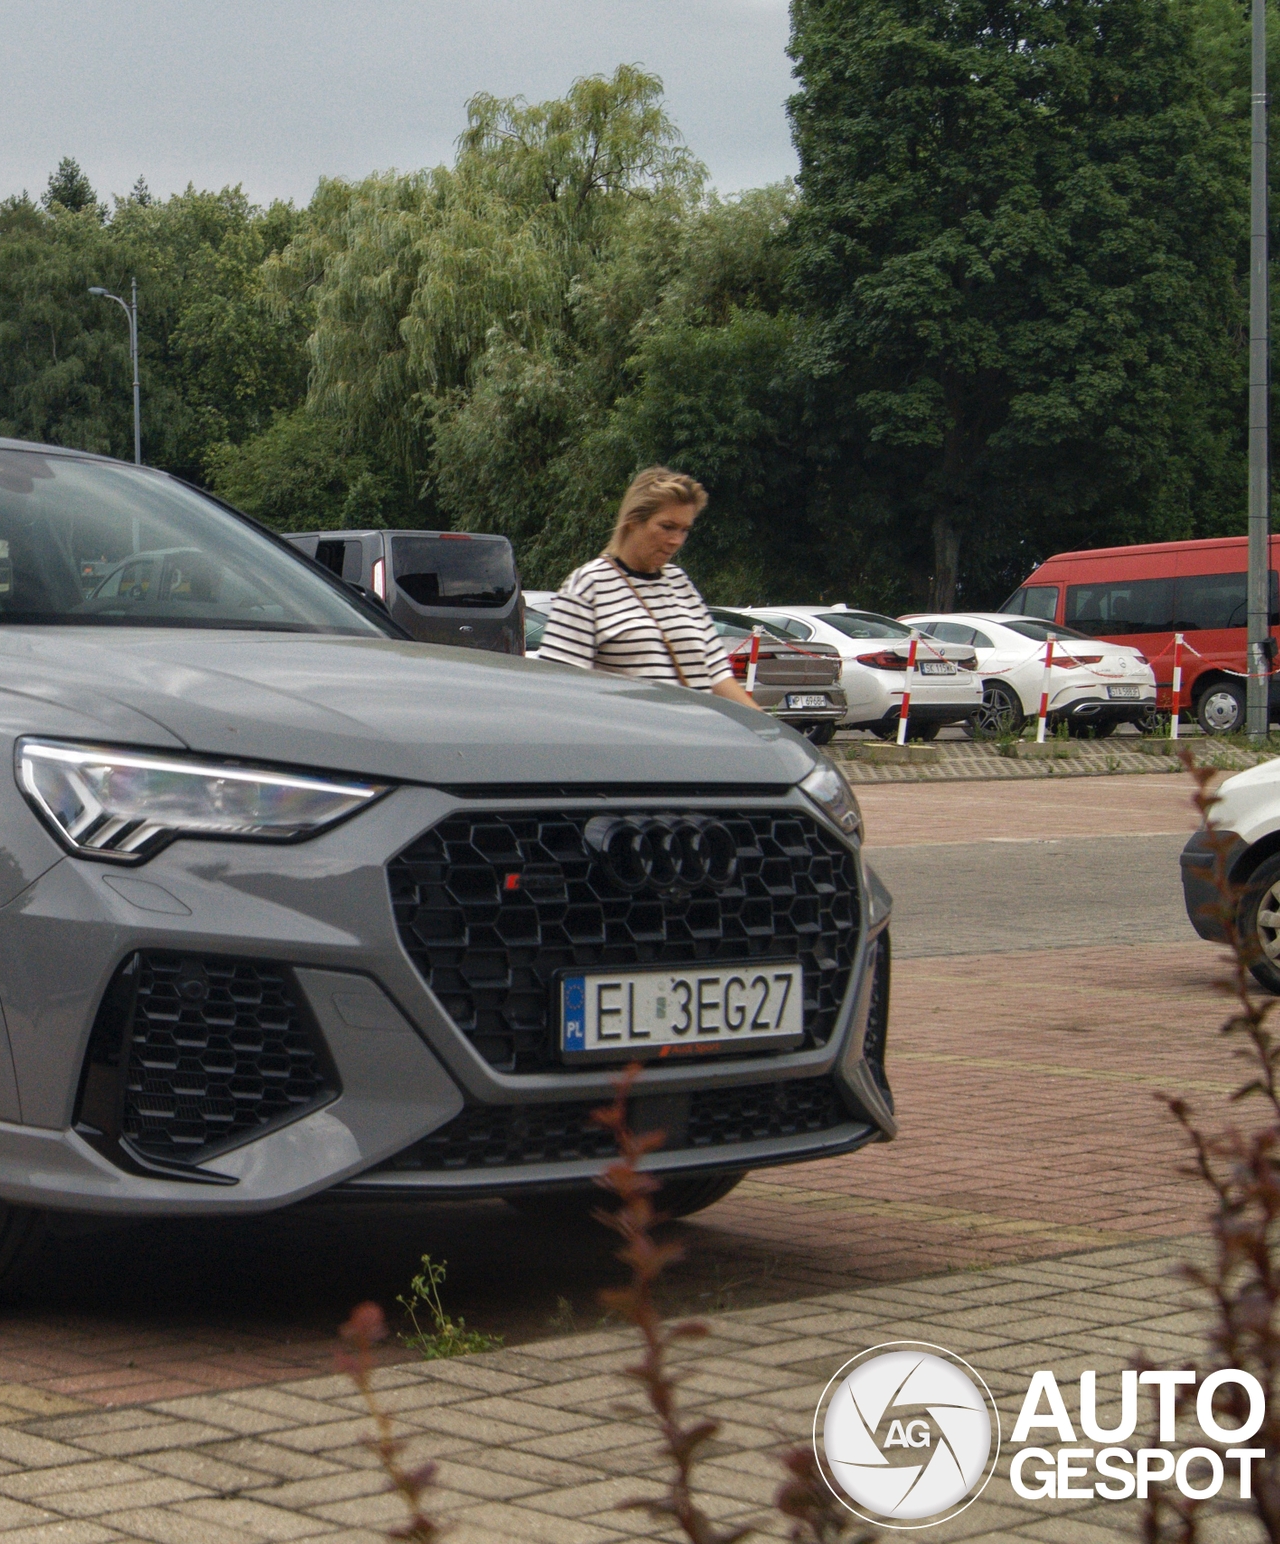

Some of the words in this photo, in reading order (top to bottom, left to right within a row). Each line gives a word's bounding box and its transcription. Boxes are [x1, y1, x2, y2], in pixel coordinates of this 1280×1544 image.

[596, 982, 651, 1042] EL
[671, 973, 794, 1035] 3EG27
[566, 1021, 583, 1039] PL
